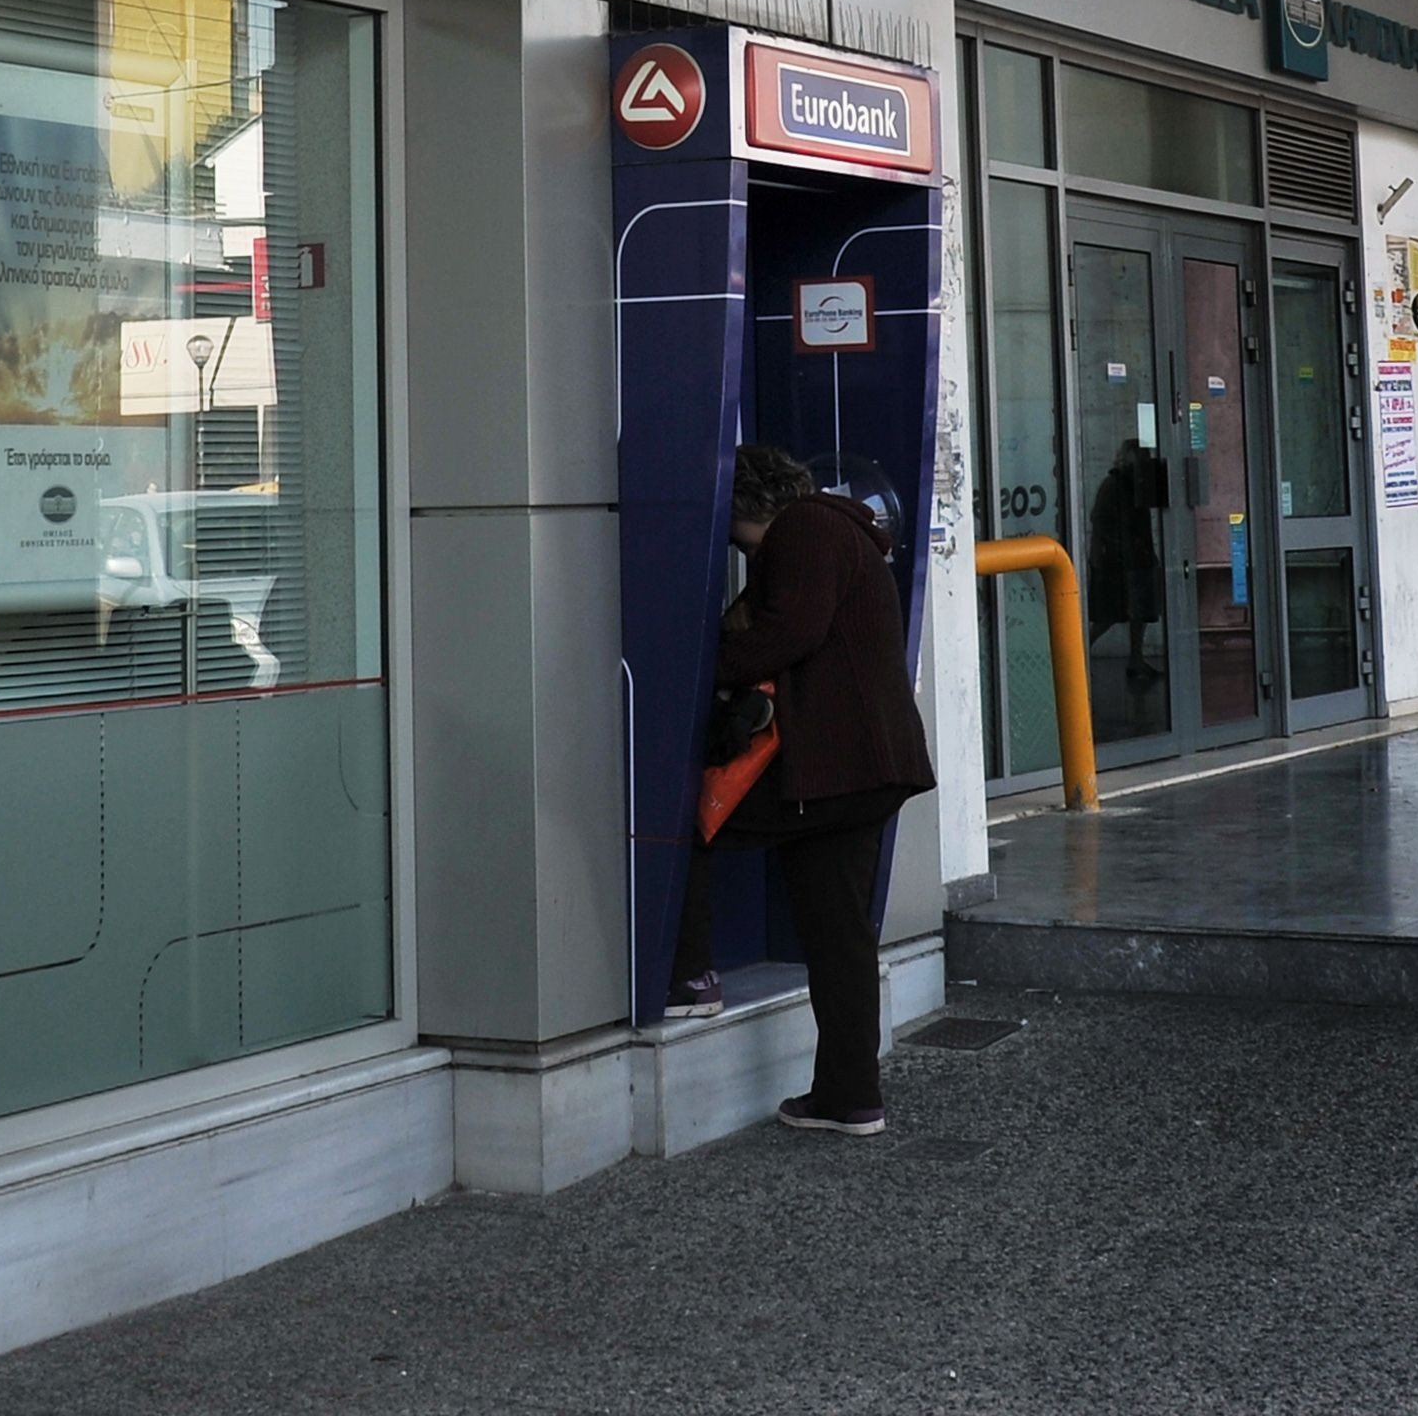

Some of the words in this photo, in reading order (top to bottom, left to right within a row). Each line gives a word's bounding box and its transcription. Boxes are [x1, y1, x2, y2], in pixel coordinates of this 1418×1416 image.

[791, 82, 899, 140] Eurobank
[0, 152, 40, 177] Εθνική
[41, 161, 61, 180] και
[10, 213, 30, 230] και
[15, 240, 35, 258] τον
[41, 267, 97, 292] τραπεζικό
[4, 448, 28, 467] Έτσι
[28, 448, 71, 471] γράφεται
[73, 453, 83, 466] το
